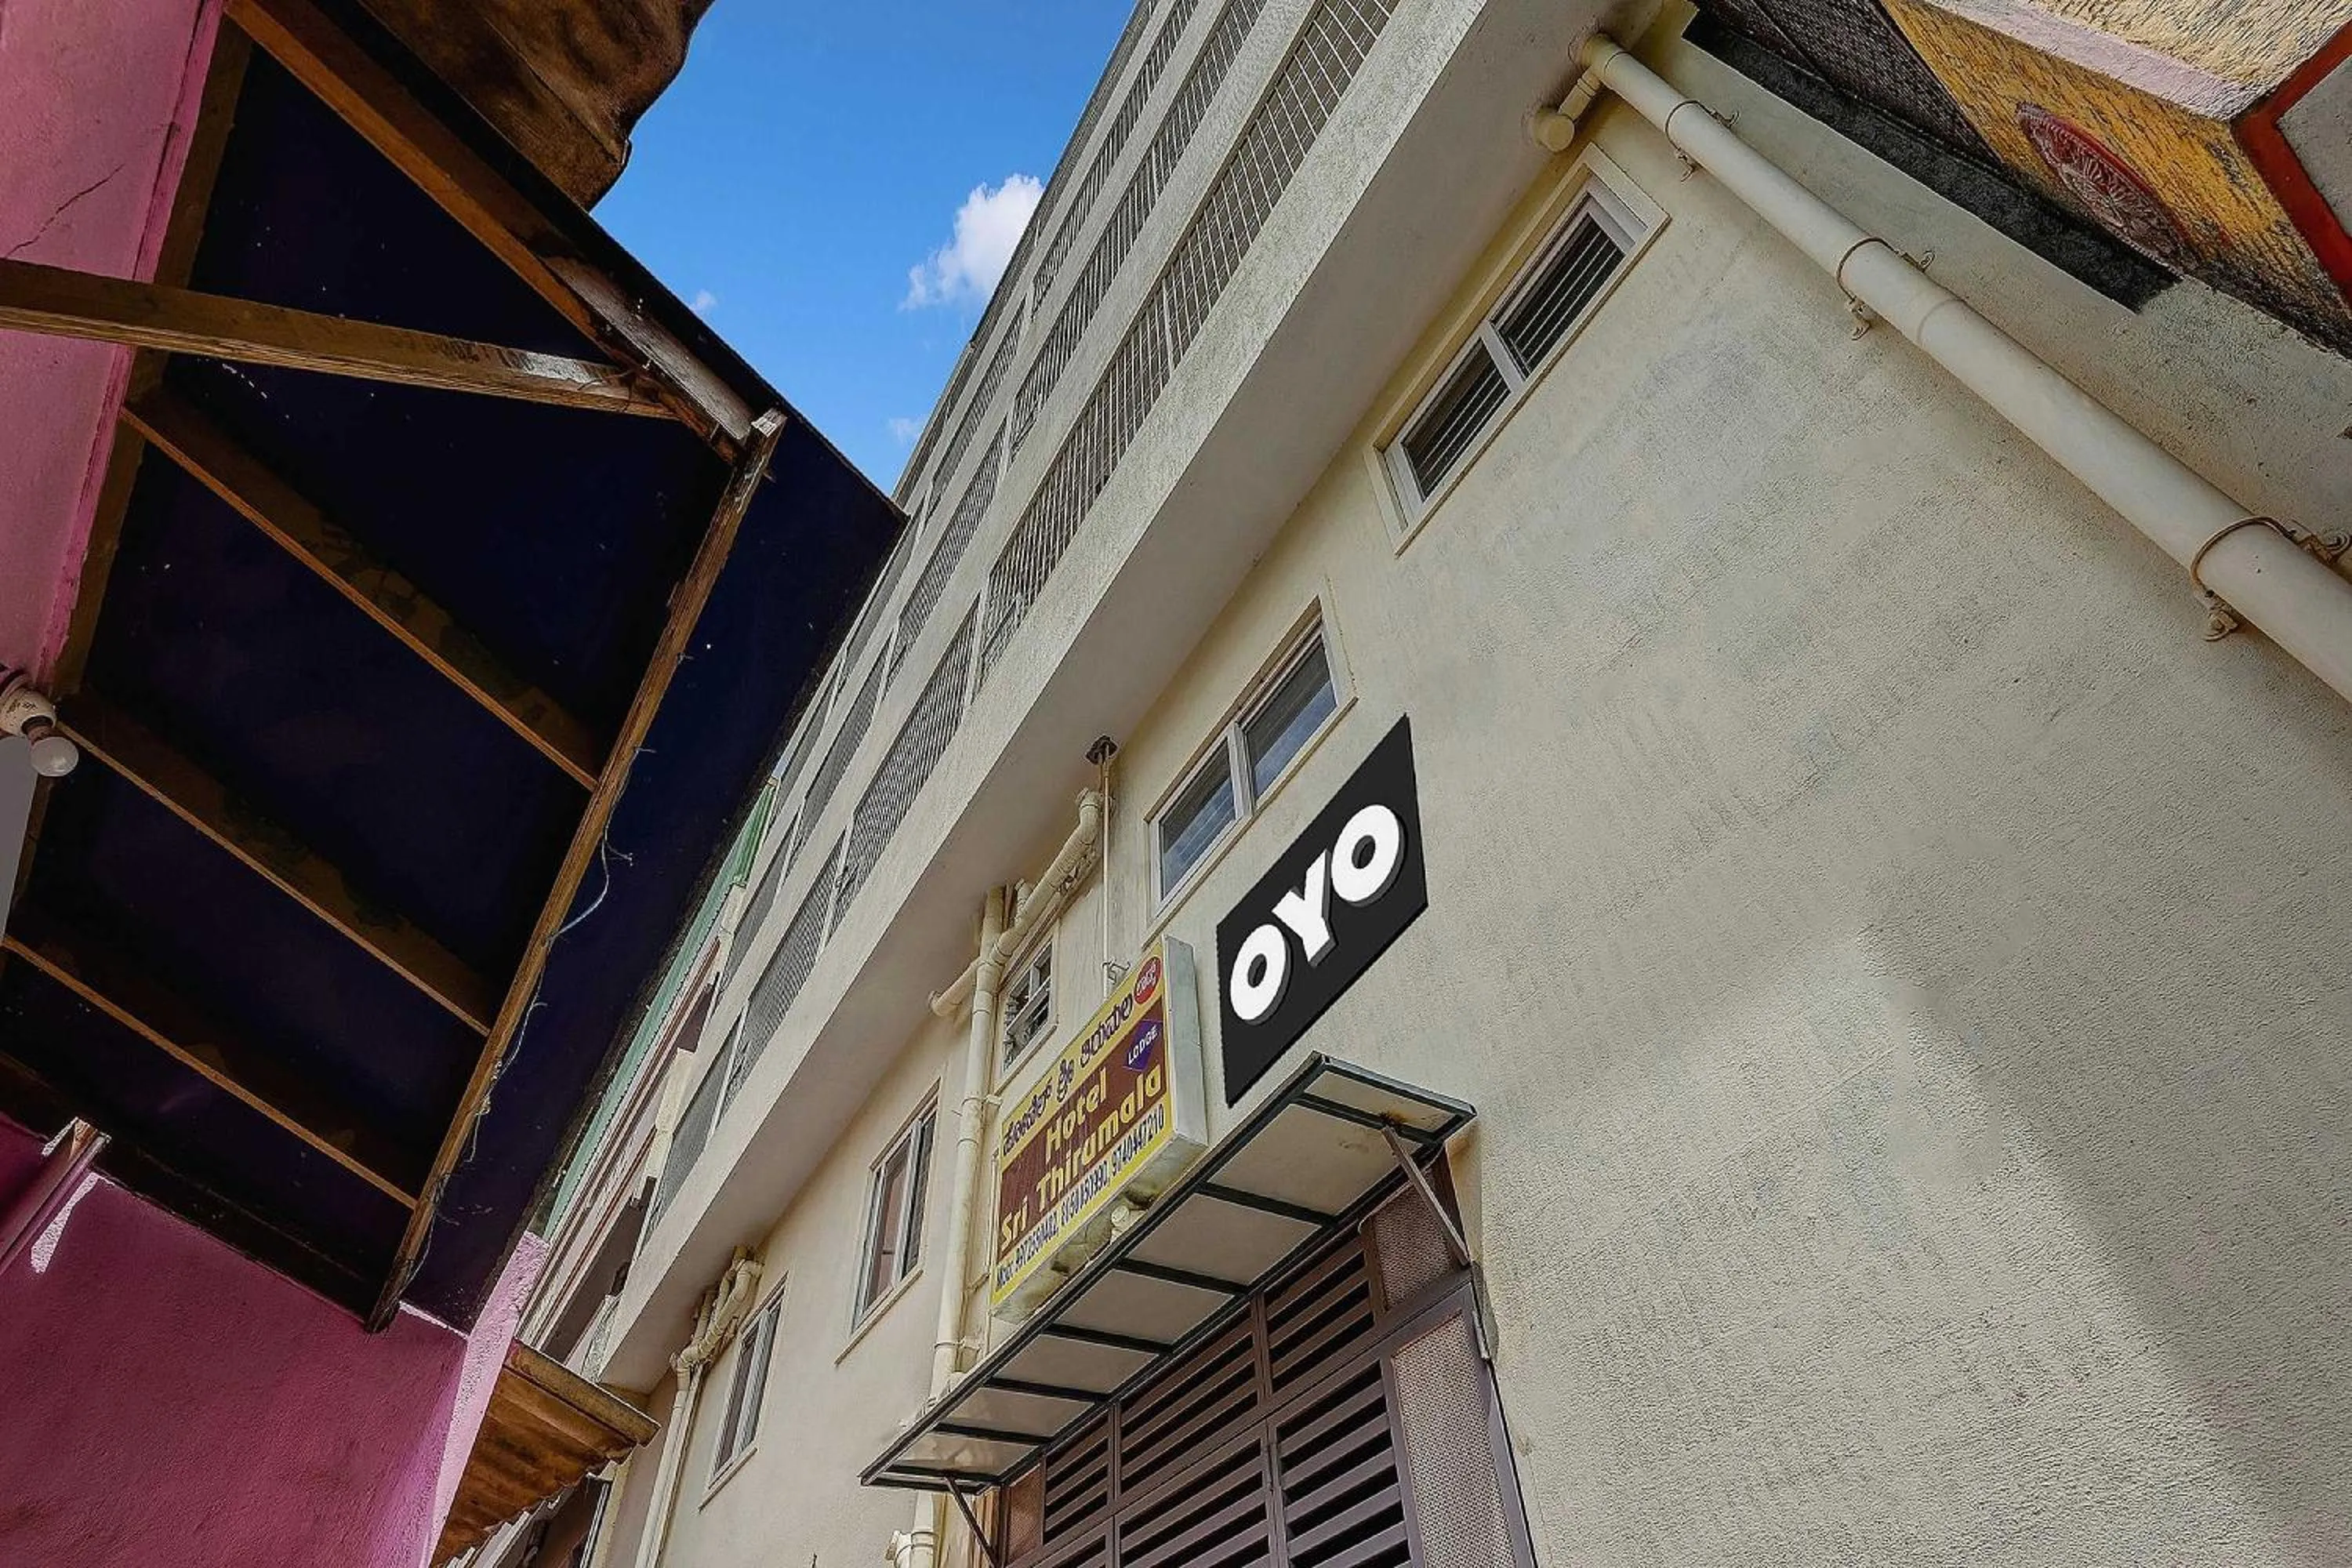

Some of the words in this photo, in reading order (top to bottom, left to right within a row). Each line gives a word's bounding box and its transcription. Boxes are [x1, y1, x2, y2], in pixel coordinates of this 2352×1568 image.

[1230, 804, 1403, 1022] OYO
[1127, 1026, 1159, 1065] LODGE
[1046, 1068, 1107, 1163] Hotel
[1001, 1194, 1028, 1252] Sri
